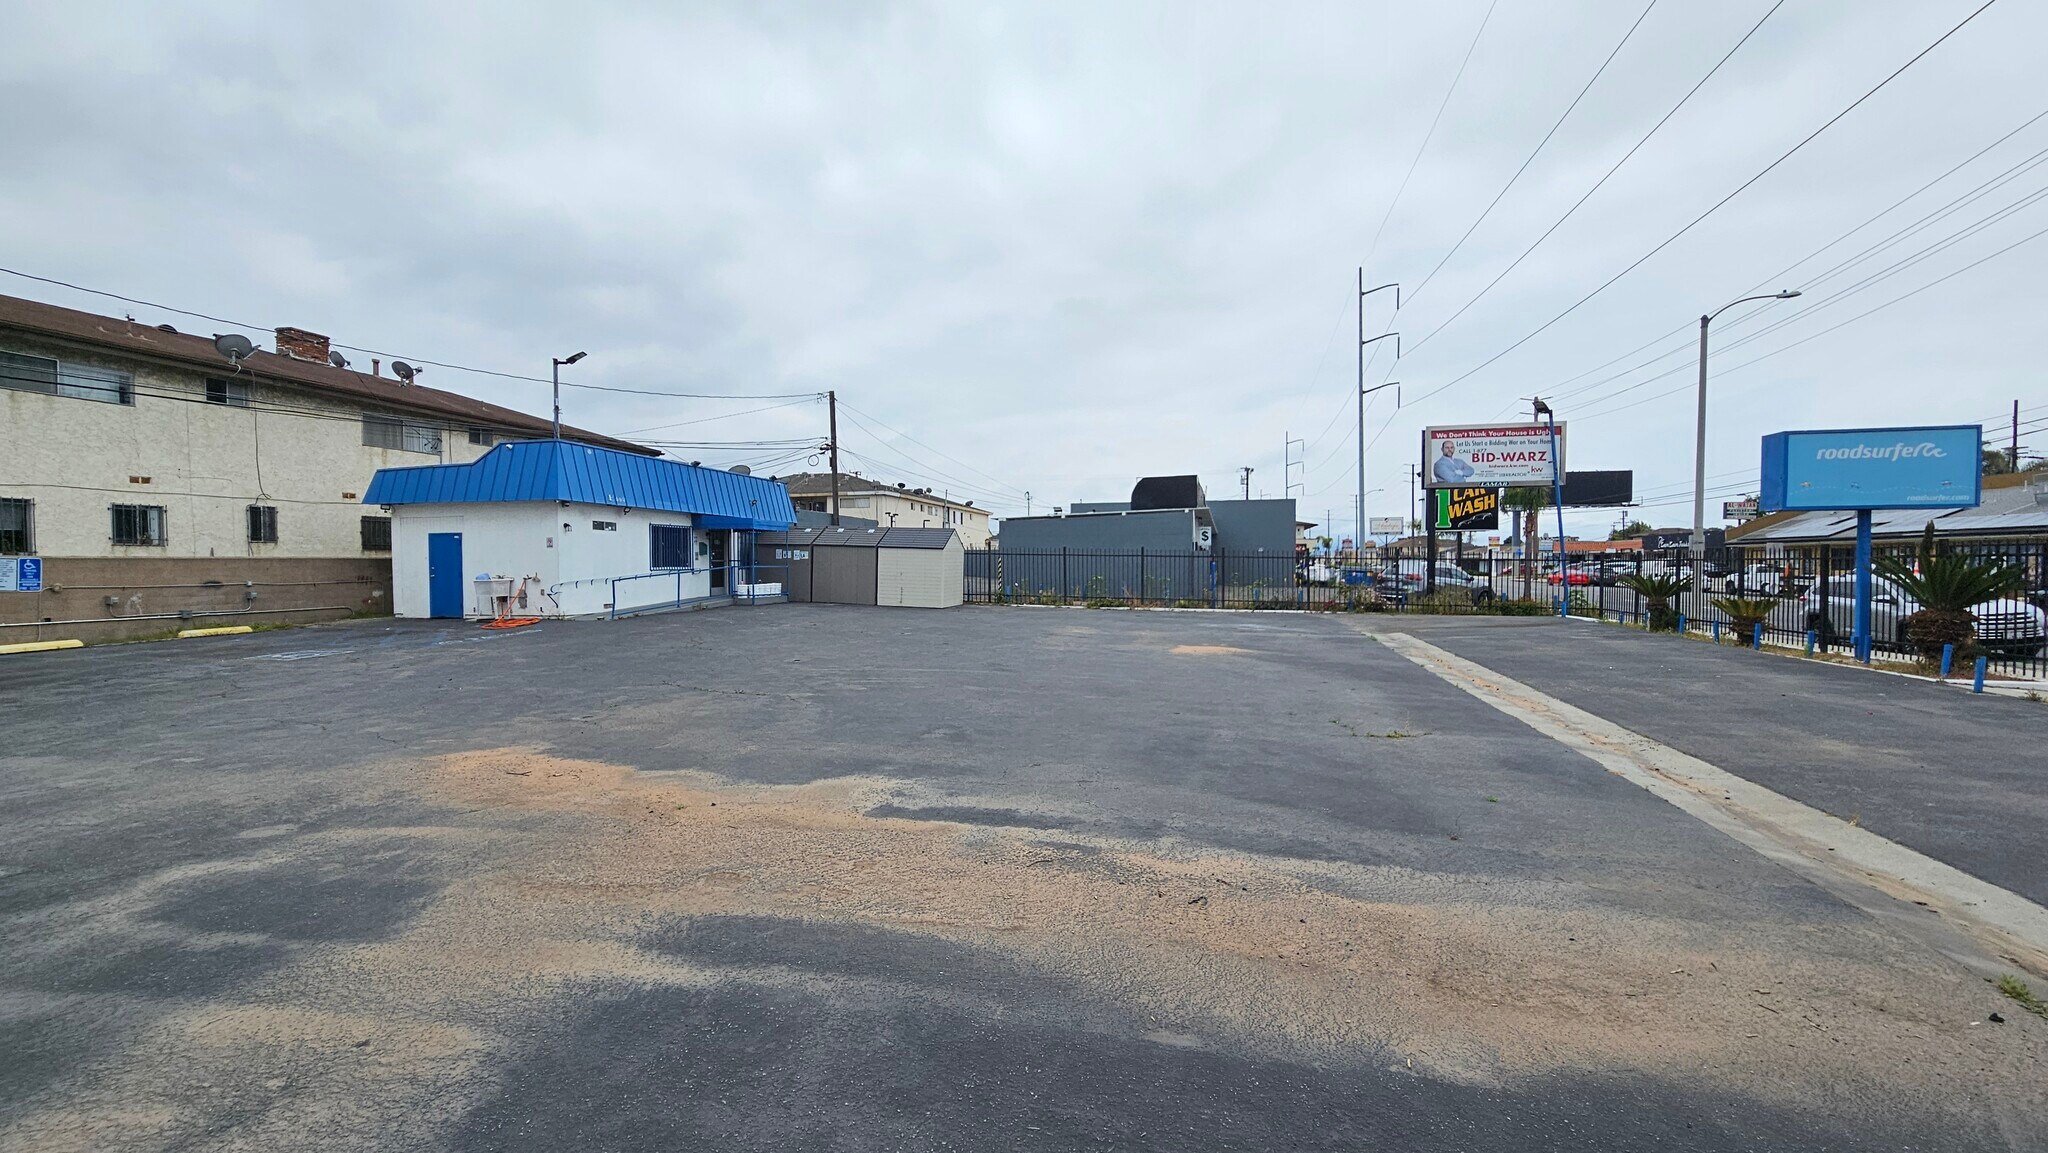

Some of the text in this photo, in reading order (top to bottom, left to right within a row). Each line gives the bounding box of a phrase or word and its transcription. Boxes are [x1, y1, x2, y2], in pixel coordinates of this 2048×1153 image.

[1489, 439, 1507, 447] Bidding
[1472, 451, 1547, 463] BID-WARZ
[1816, 442, 1947, 462] roadsurfer
[1531, 465, 1544, 473] kw
[1906, 494, 1970, 502] roadsurfer.com
[1448, 494, 1496, 519] WASH
